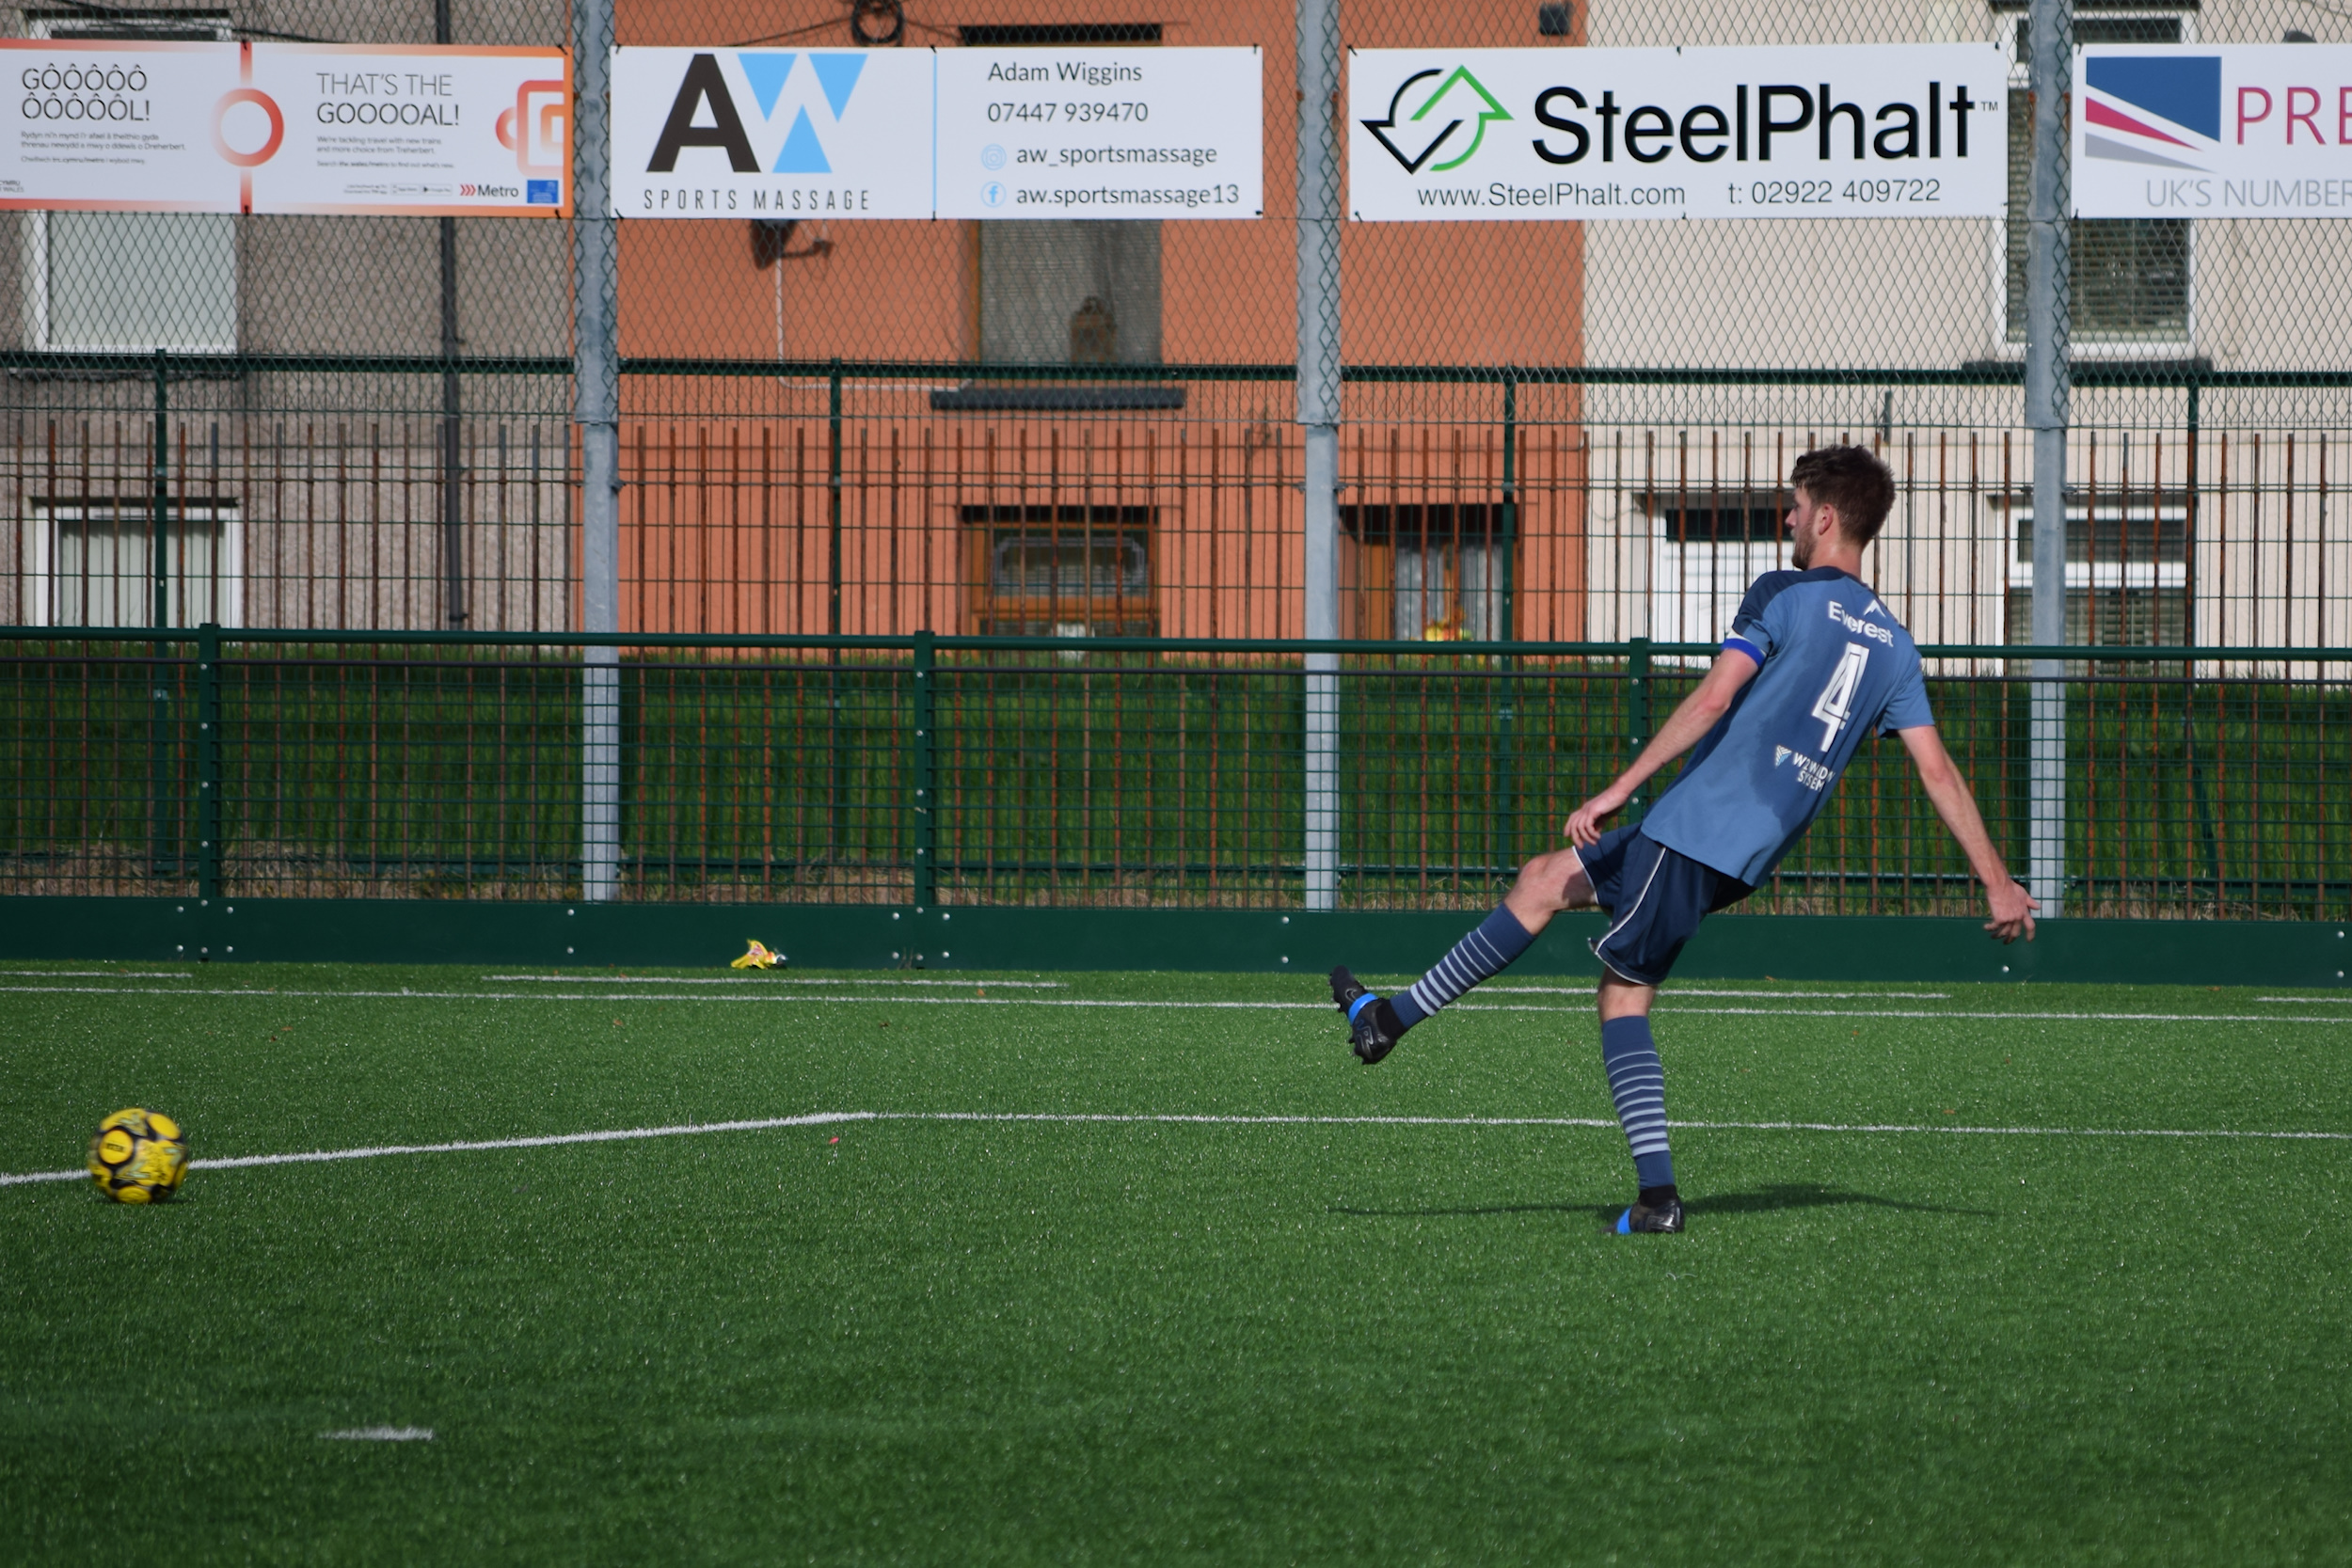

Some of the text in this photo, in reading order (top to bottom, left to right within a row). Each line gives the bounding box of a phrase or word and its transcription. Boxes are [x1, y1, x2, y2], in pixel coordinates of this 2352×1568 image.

[405, 74, 453, 96] THE
[988, 62, 1143, 86] Adam Wiggins
[316, 102, 459, 126] GOOOOAL!
[988, 103, 1149, 122] 07447 939470
[1532, 81, 1976, 165] SteelPhalt
[1016, 145, 1217, 166] aw_sportsmassage
[477, 183, 519, 198] Metro
[644, 189, 869, 211] SPORTS MASSAGE
[1016, 183, 1240, 208] aw.sportsmassage13
[1418, 178, 1941, 207] www.SteelPhalt.com t: 02922 409722
[1828, 600, 1894, 648] Everest
[1811, 641, 1870, 752] 4
